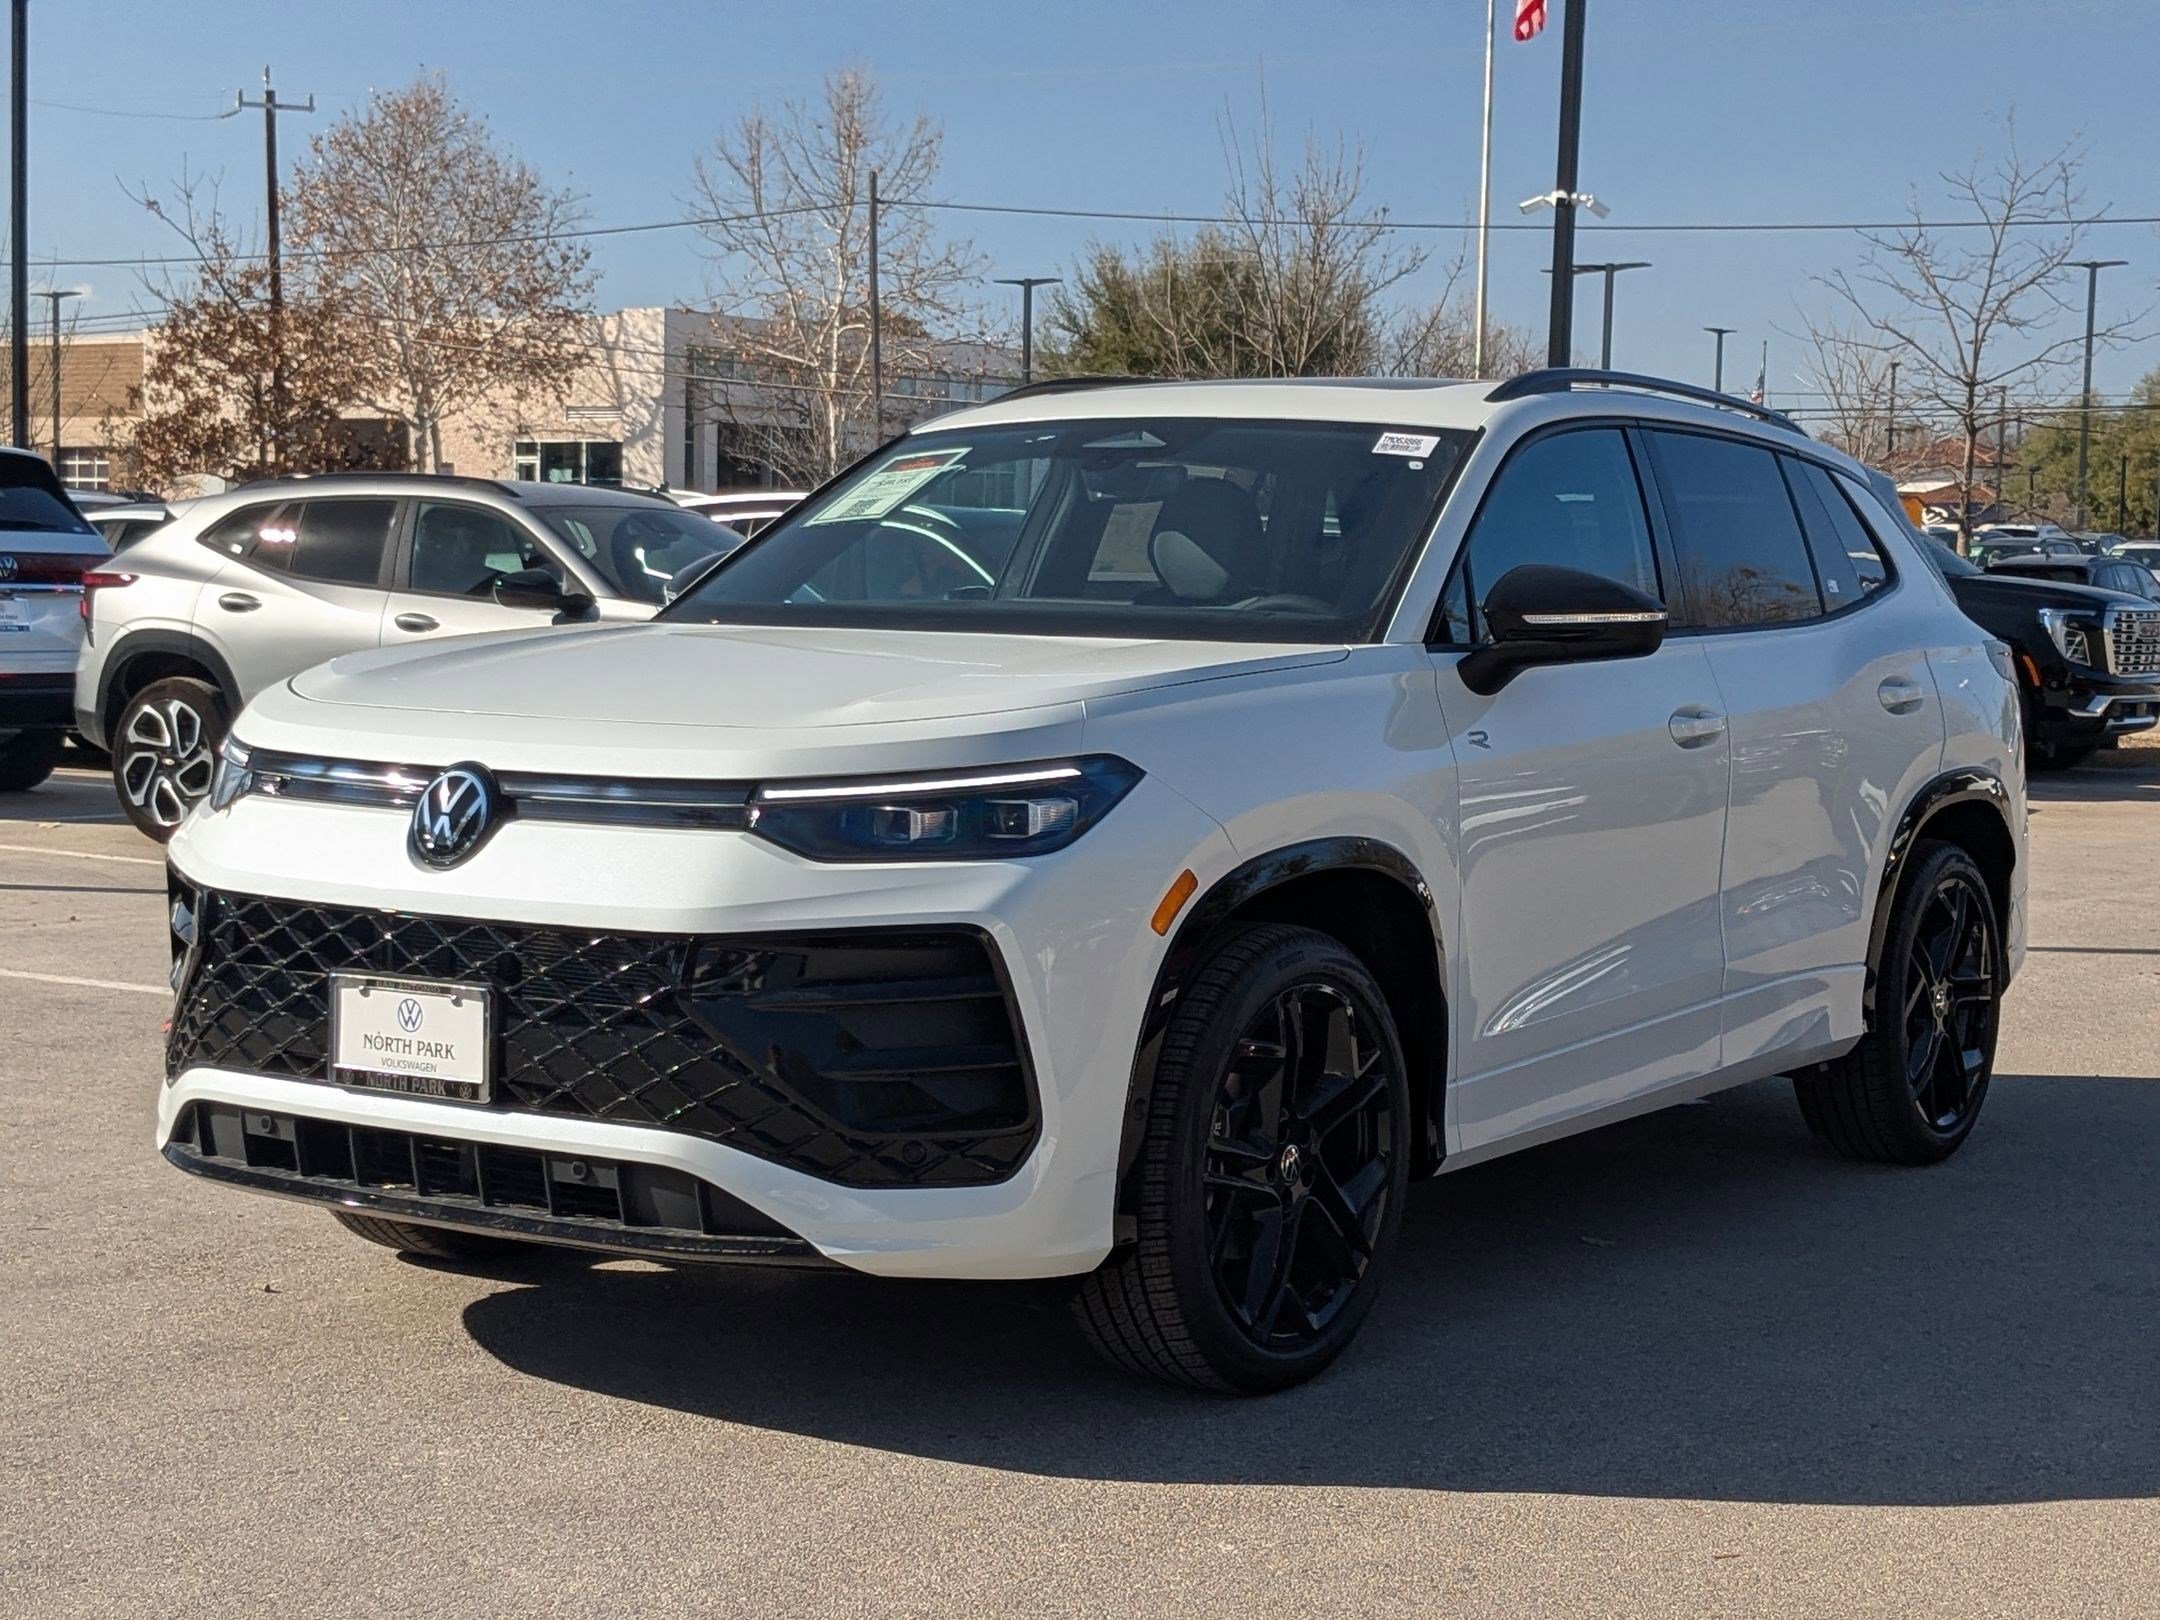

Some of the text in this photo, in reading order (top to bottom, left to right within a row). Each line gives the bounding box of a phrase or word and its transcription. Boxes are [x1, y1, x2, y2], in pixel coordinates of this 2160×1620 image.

[1467, 730, 1492, 750] R
[415, 771, 487, 860] VW
[398, 998, 423, 1033] VW
[363, 1032, 456, 1060] NORTH PARK
[381, 1057, 438, 1073] VOLKSWAGEN
[366, 1072, 447, 1096] NORTH PARK
